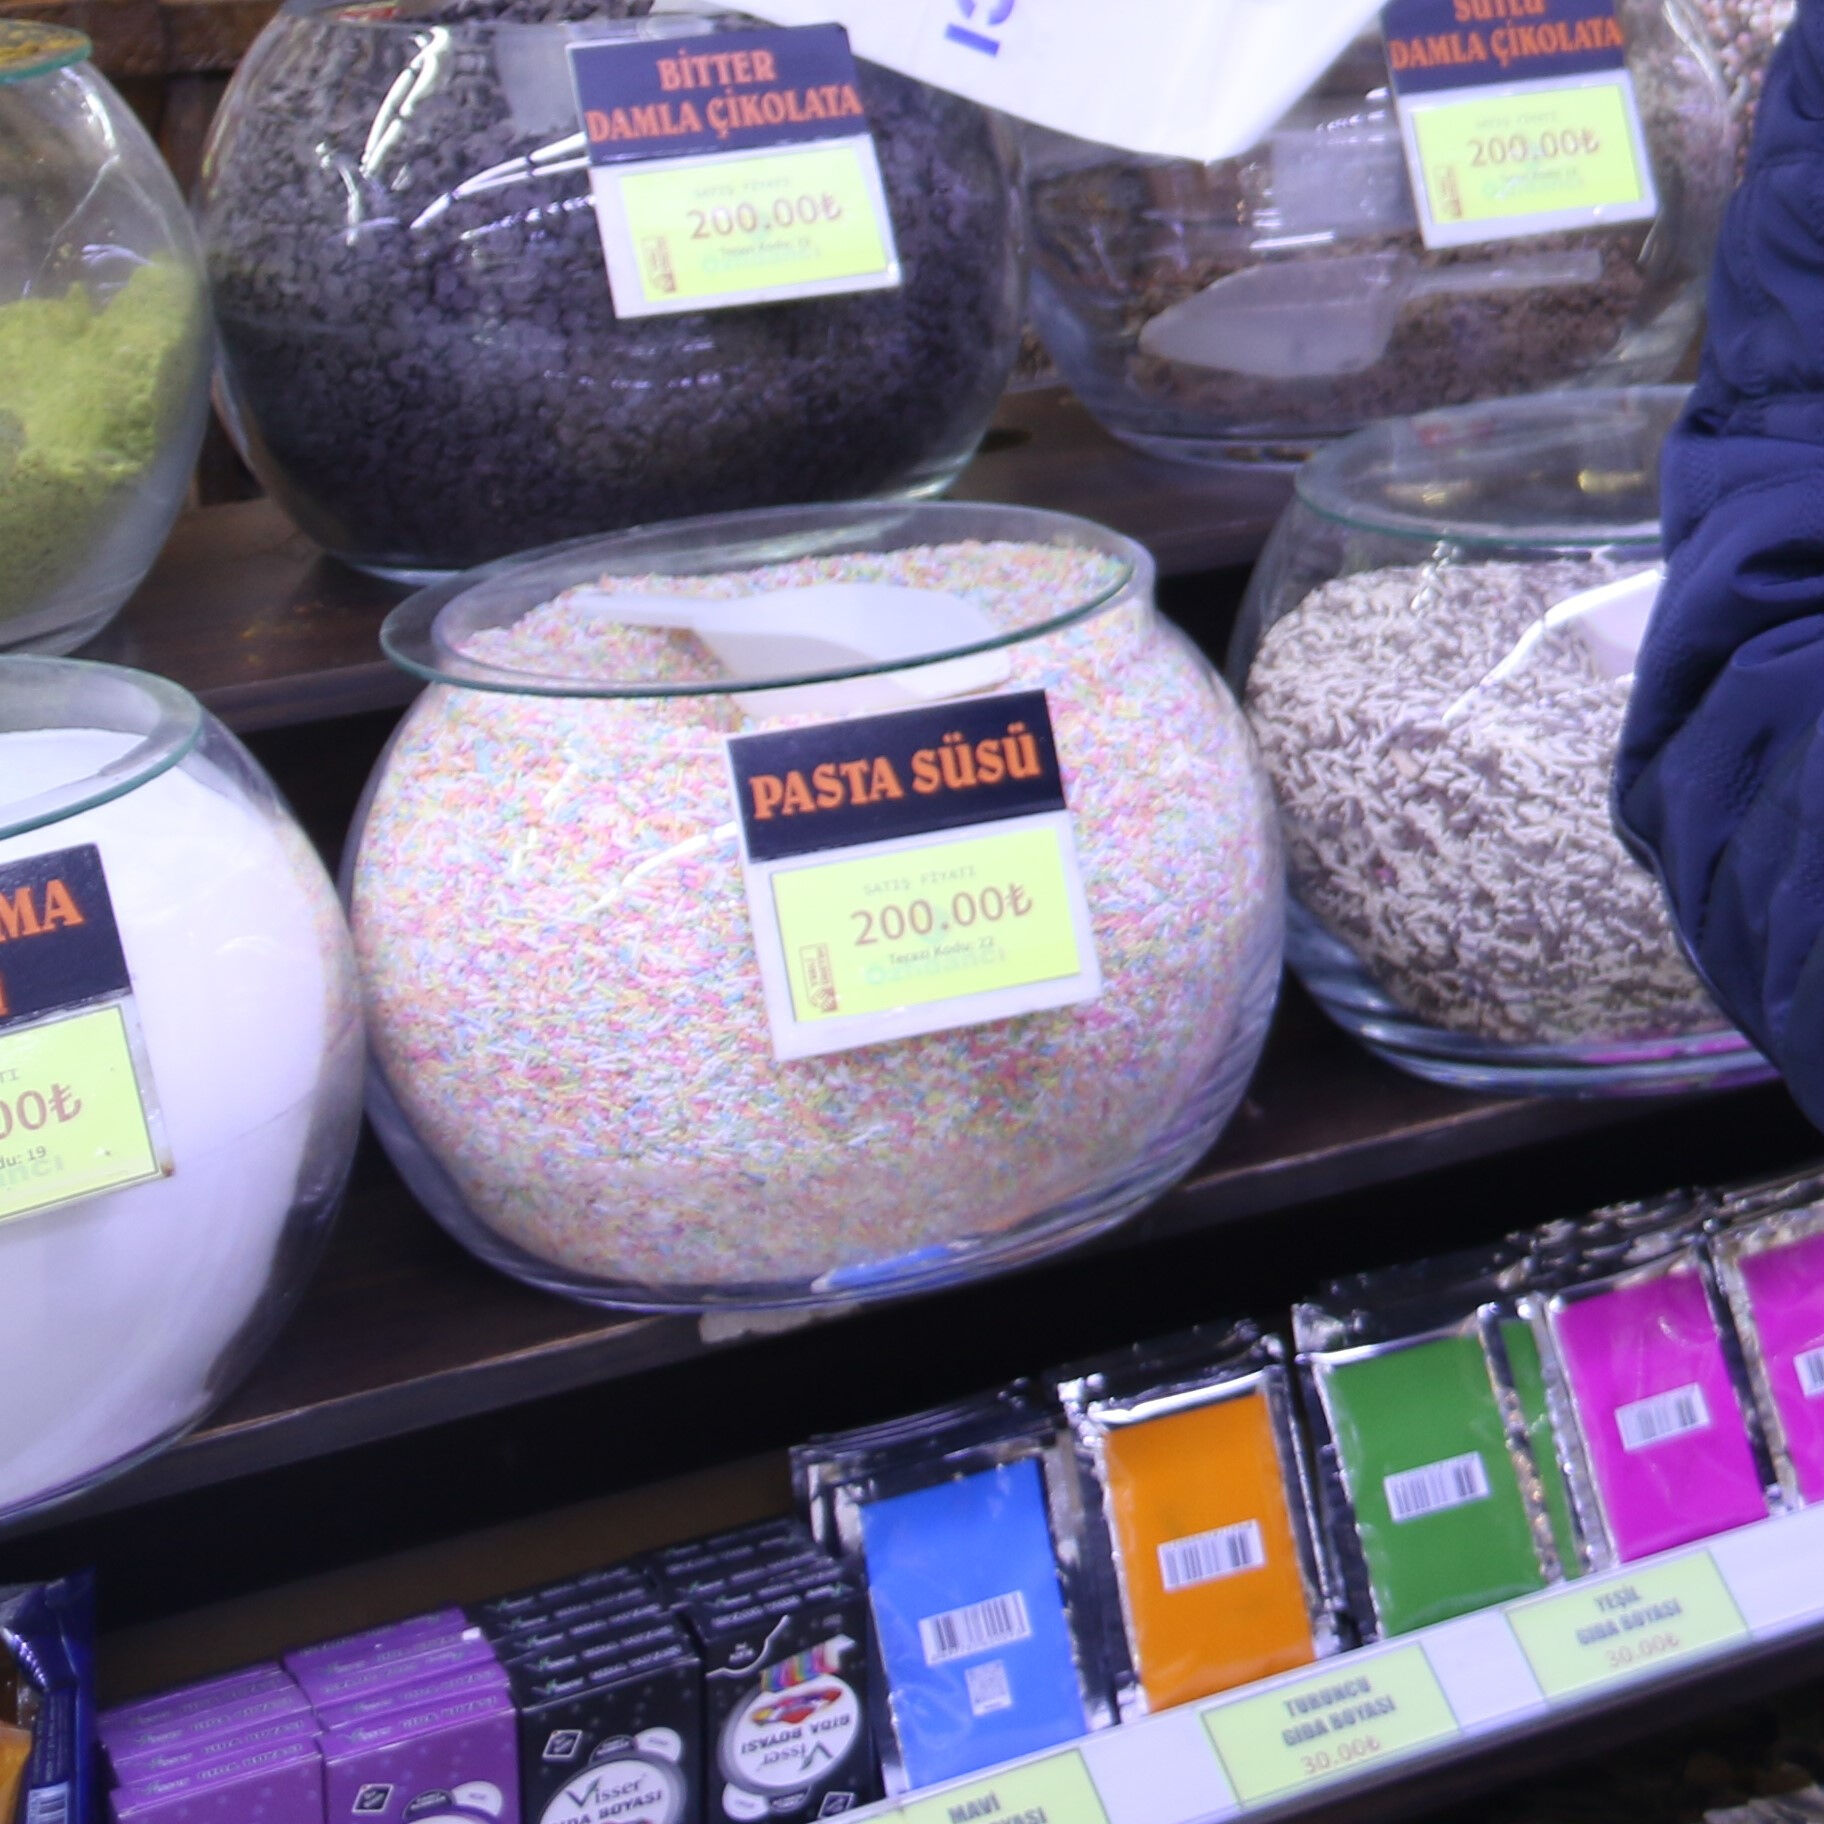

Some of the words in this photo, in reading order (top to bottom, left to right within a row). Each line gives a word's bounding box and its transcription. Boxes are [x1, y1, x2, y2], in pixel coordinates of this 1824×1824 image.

[656, 48, 778, 93] BİTTER
[1388, 30, 1488, 72] DAMLA
[1490, 14, 1624, 68] ÇİKOLATA
[584, 100, 703, 145] DAMLA
[705, 82, 865, 140] ÇİKOLATA
[685, 191, 844, 240] 200.00₺
[750, 757, 904, 820] PASTA
[911, 721, 1042, 794] SÜSÜ
[849, 881, 1034, 948] 200.00₺
